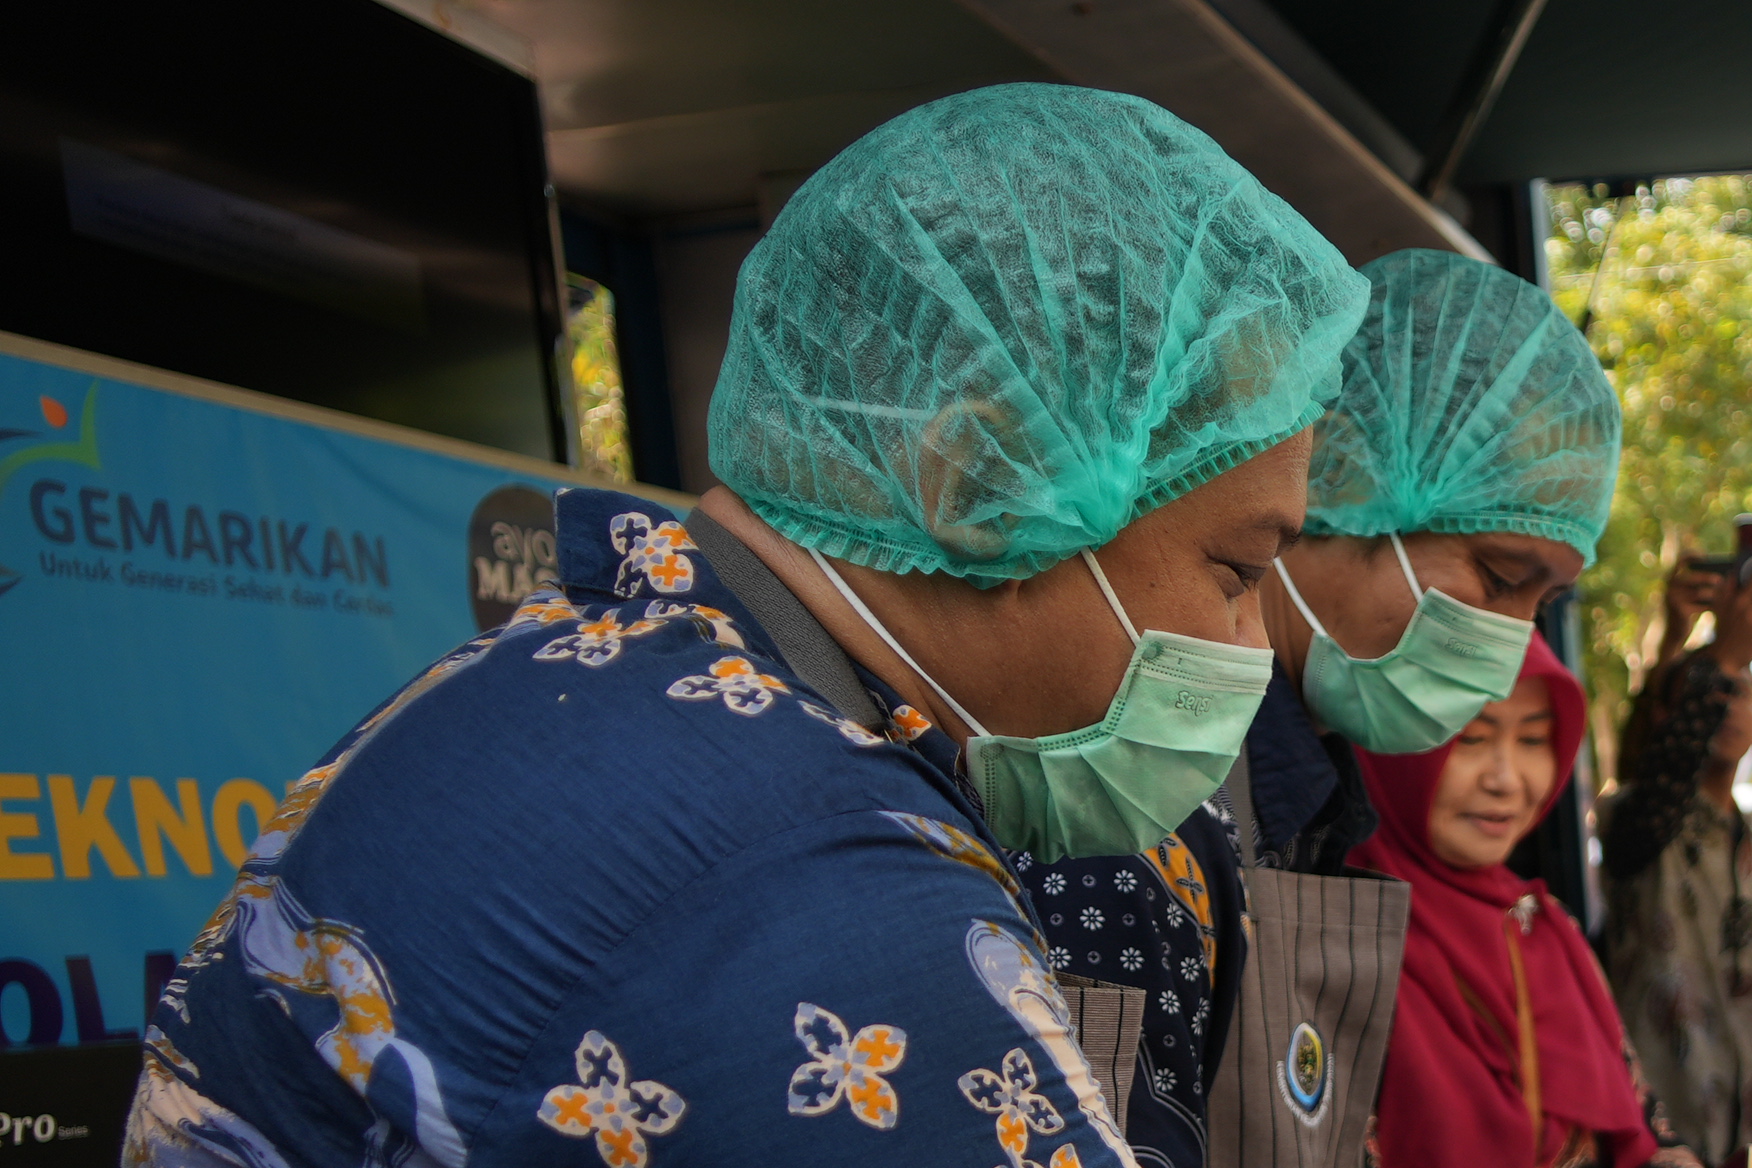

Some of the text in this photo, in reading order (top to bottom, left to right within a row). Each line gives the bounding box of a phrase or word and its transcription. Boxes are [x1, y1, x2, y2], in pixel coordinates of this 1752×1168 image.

[29, 476, 391, 589] GEMARIKAN
[39, 549, 114, 582] Untuk
[0, 773, 300, 880] EKNO
